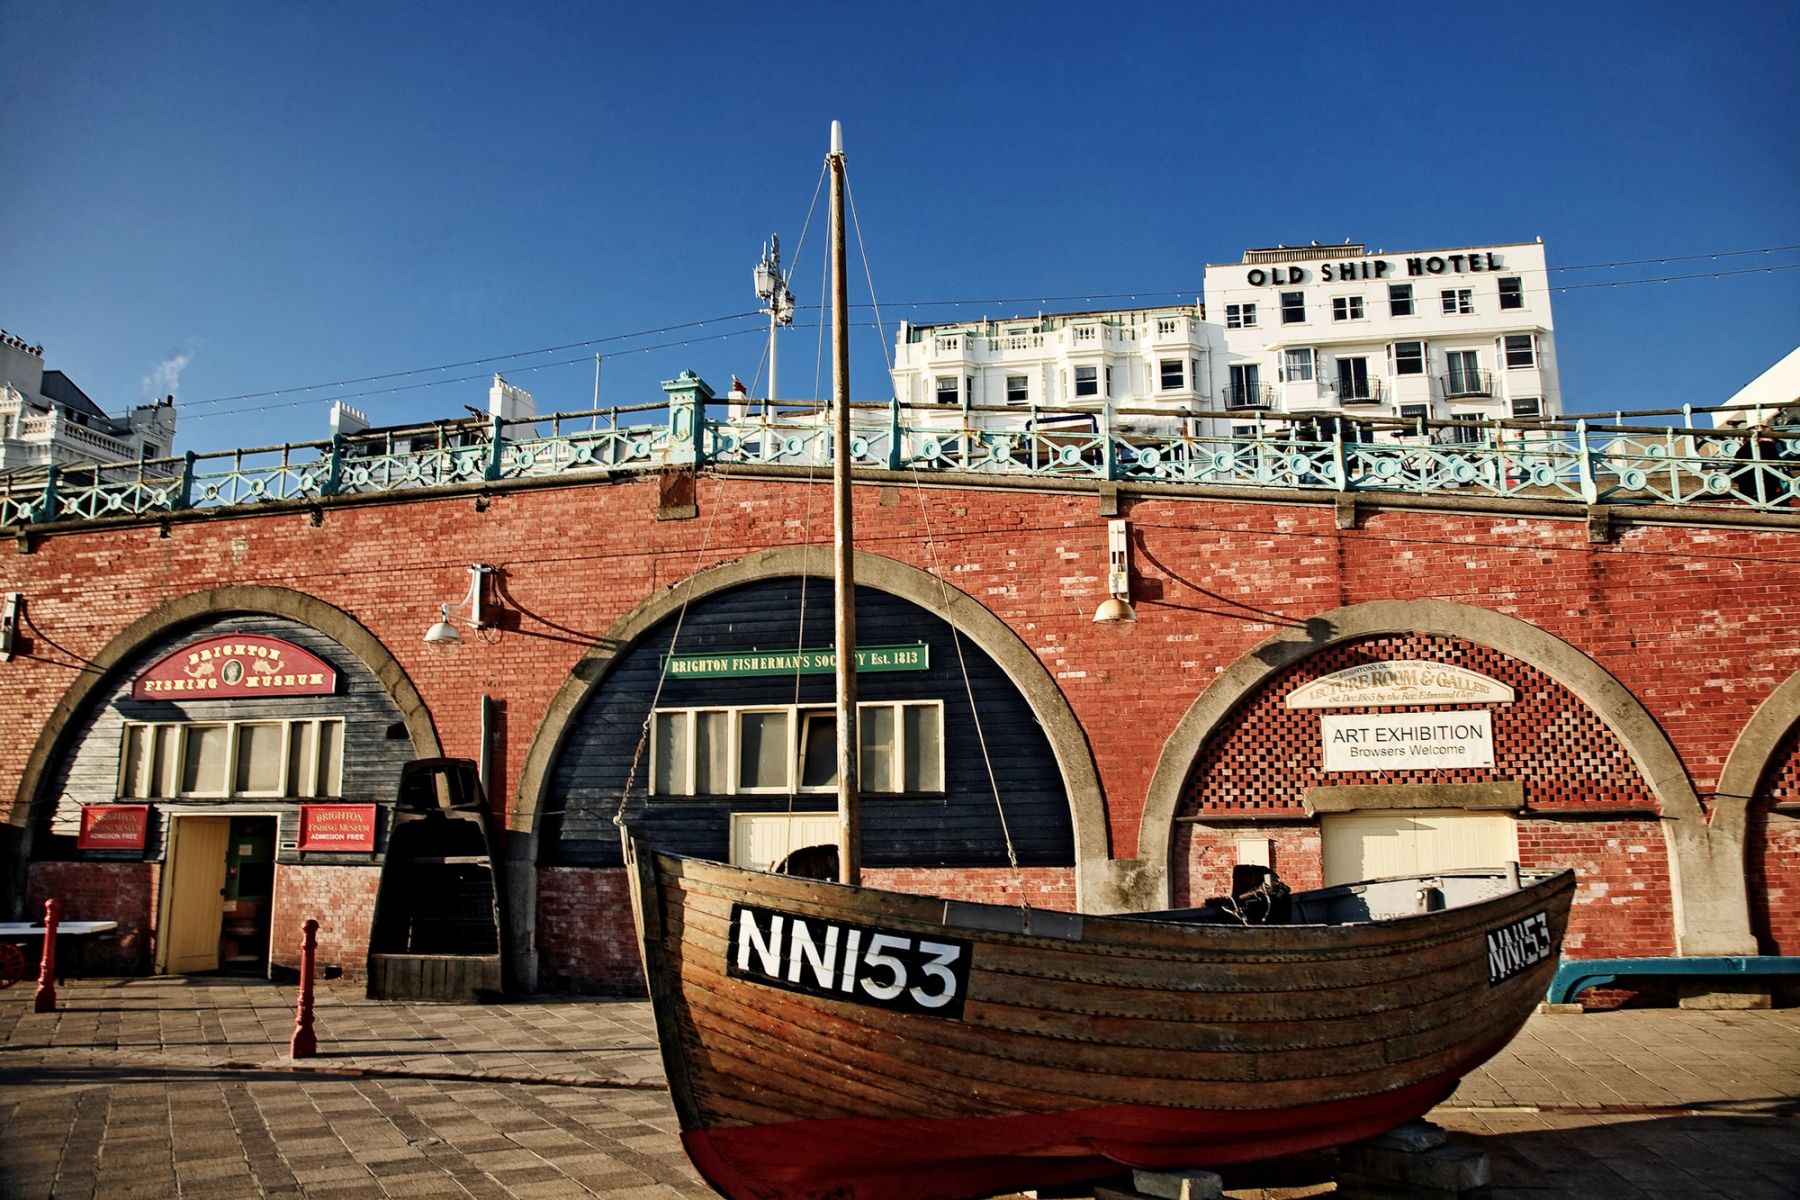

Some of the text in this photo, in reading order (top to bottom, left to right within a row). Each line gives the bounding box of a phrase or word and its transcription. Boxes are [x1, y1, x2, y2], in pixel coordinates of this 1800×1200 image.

[1247, 252, 1502, 286] OLD SHIP HOTEL
[188, 644, 281, 665] BRIGHTON
[671, 651, 918, 673] BRIGHTON FISHERMAN'S SOCY Est. 1813
[1425, 663, 1457, 673] QUARTER
[144, 673, 324, 692] FISHING MUSEUM
[1309, 669, 1492, 700] LECTURE ROOM & GALLERY
[1333, 724, 1483, 743] ART EXHIBITION
[1350, 744, 1466, 758] Browsers Welcome
[315, 811, 363, 822] BRIGHTON
[1487, 912, 1551, 982] NN153
[737, 909, 961, 1008] NN153
